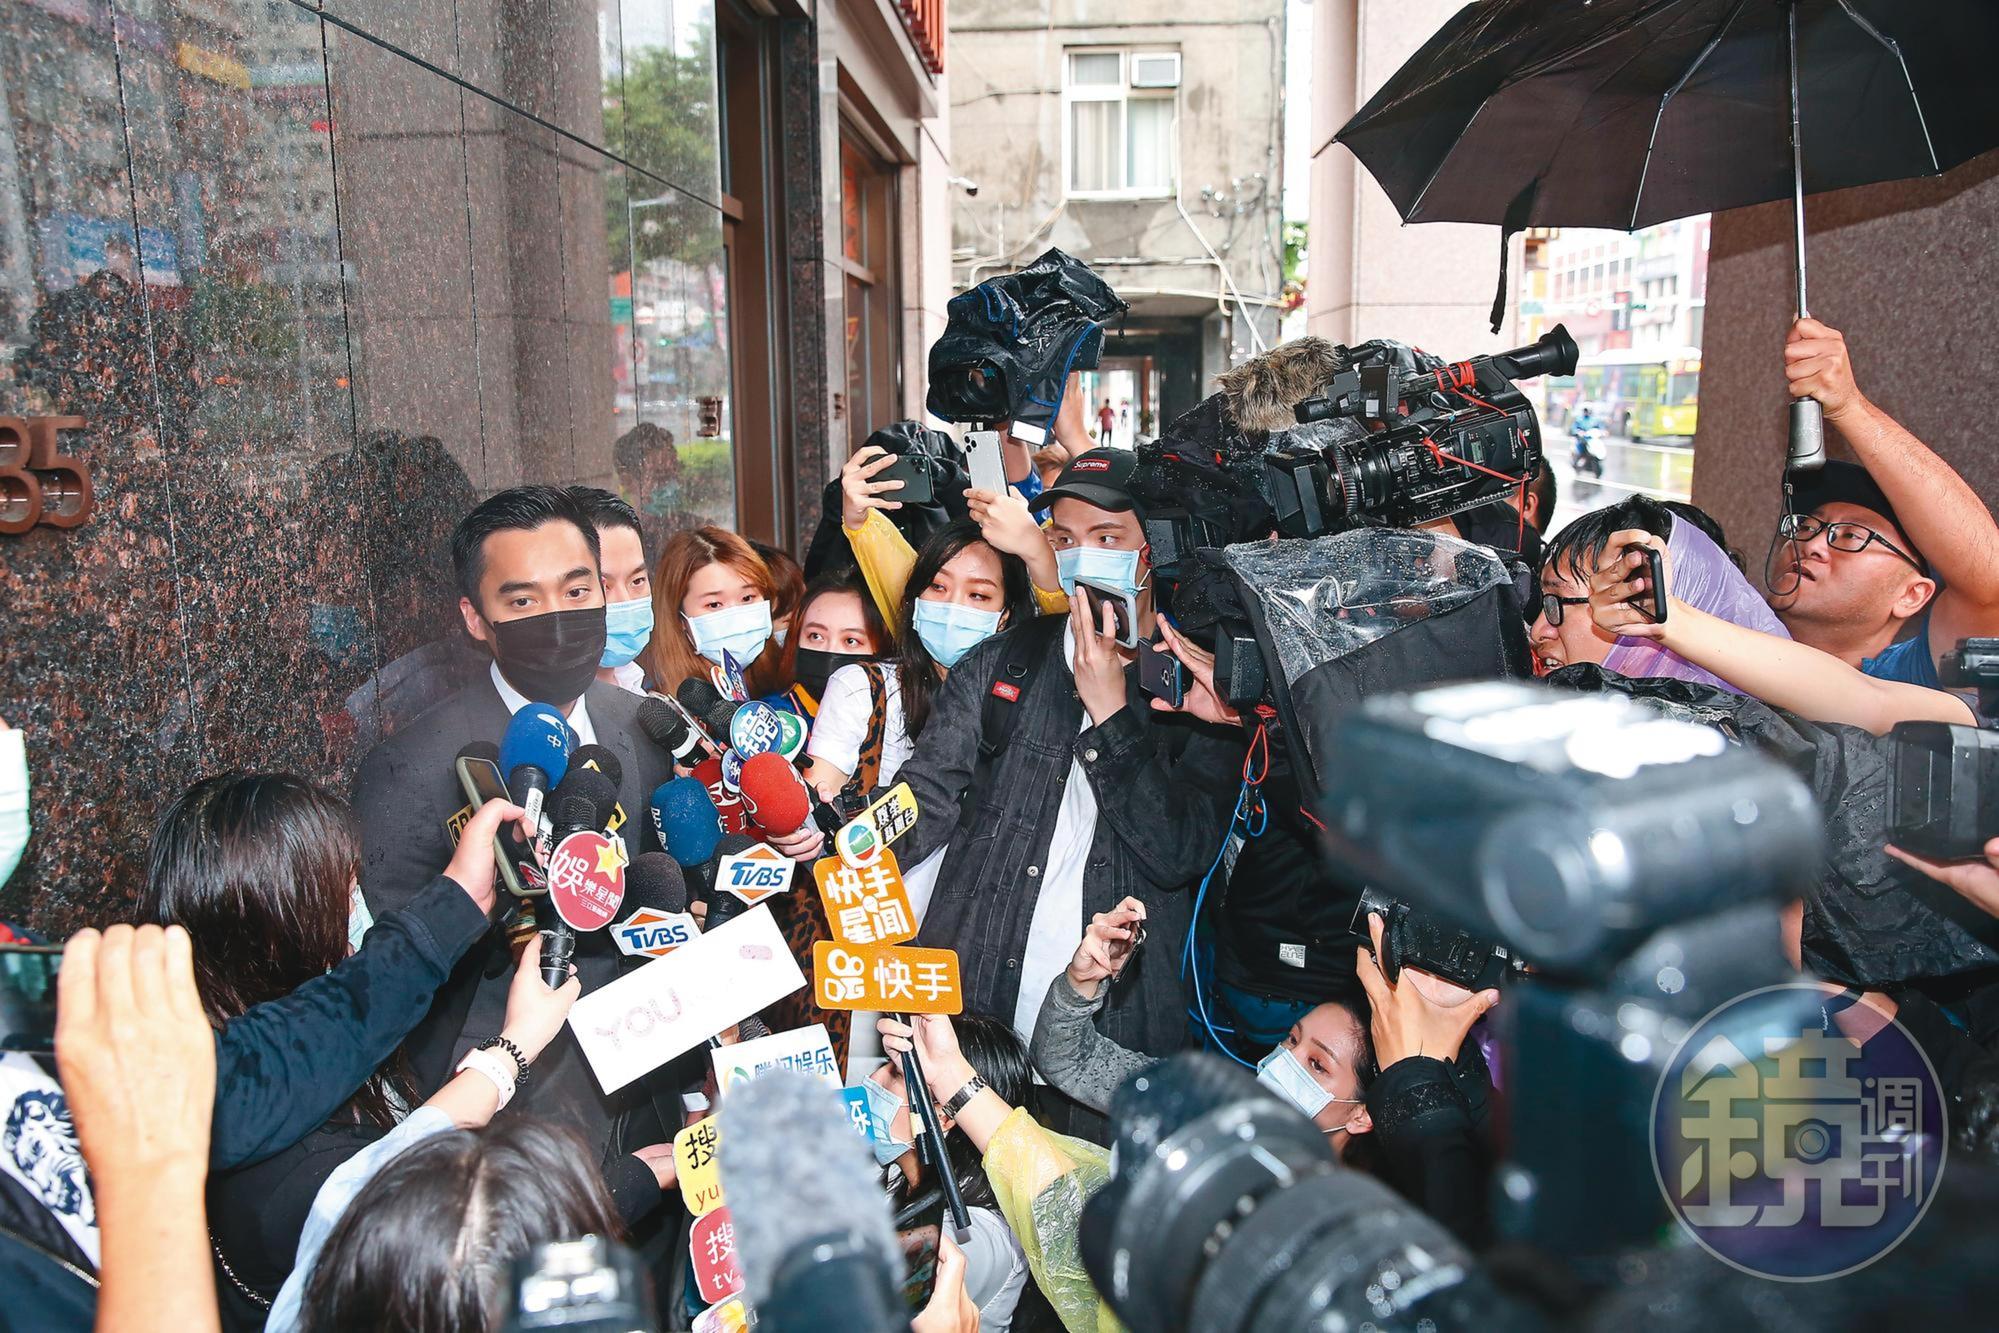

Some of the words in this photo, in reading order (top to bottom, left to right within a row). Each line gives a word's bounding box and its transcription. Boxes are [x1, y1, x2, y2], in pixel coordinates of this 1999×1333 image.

[1074, 461, 1108, 470] Supreme
[730, 862, 787, 886] TVBS
[825, 854, 896, 905] 快手
[622, 924, 689, 949] TVBS
[839, 898, 911, 946] 星闻
[873, 958, 953, 1001] 快手
